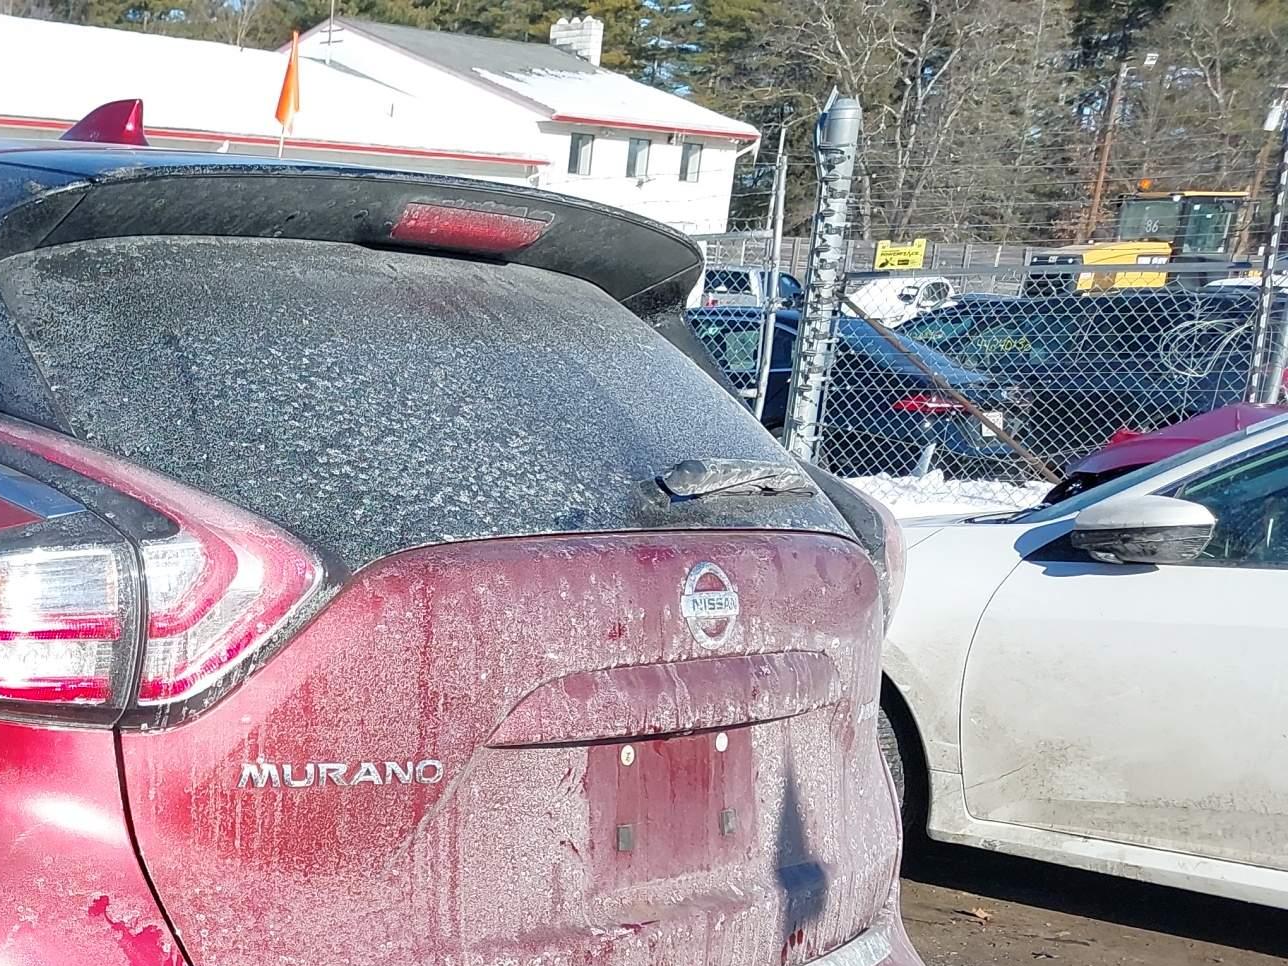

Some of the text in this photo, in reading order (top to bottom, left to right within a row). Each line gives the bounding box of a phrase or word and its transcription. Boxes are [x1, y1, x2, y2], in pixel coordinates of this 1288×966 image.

[1145, 219, 1159, 233] 86
[692, 597, 737, 611] NISSAN
[237, 759, 444, 788] MURANO
